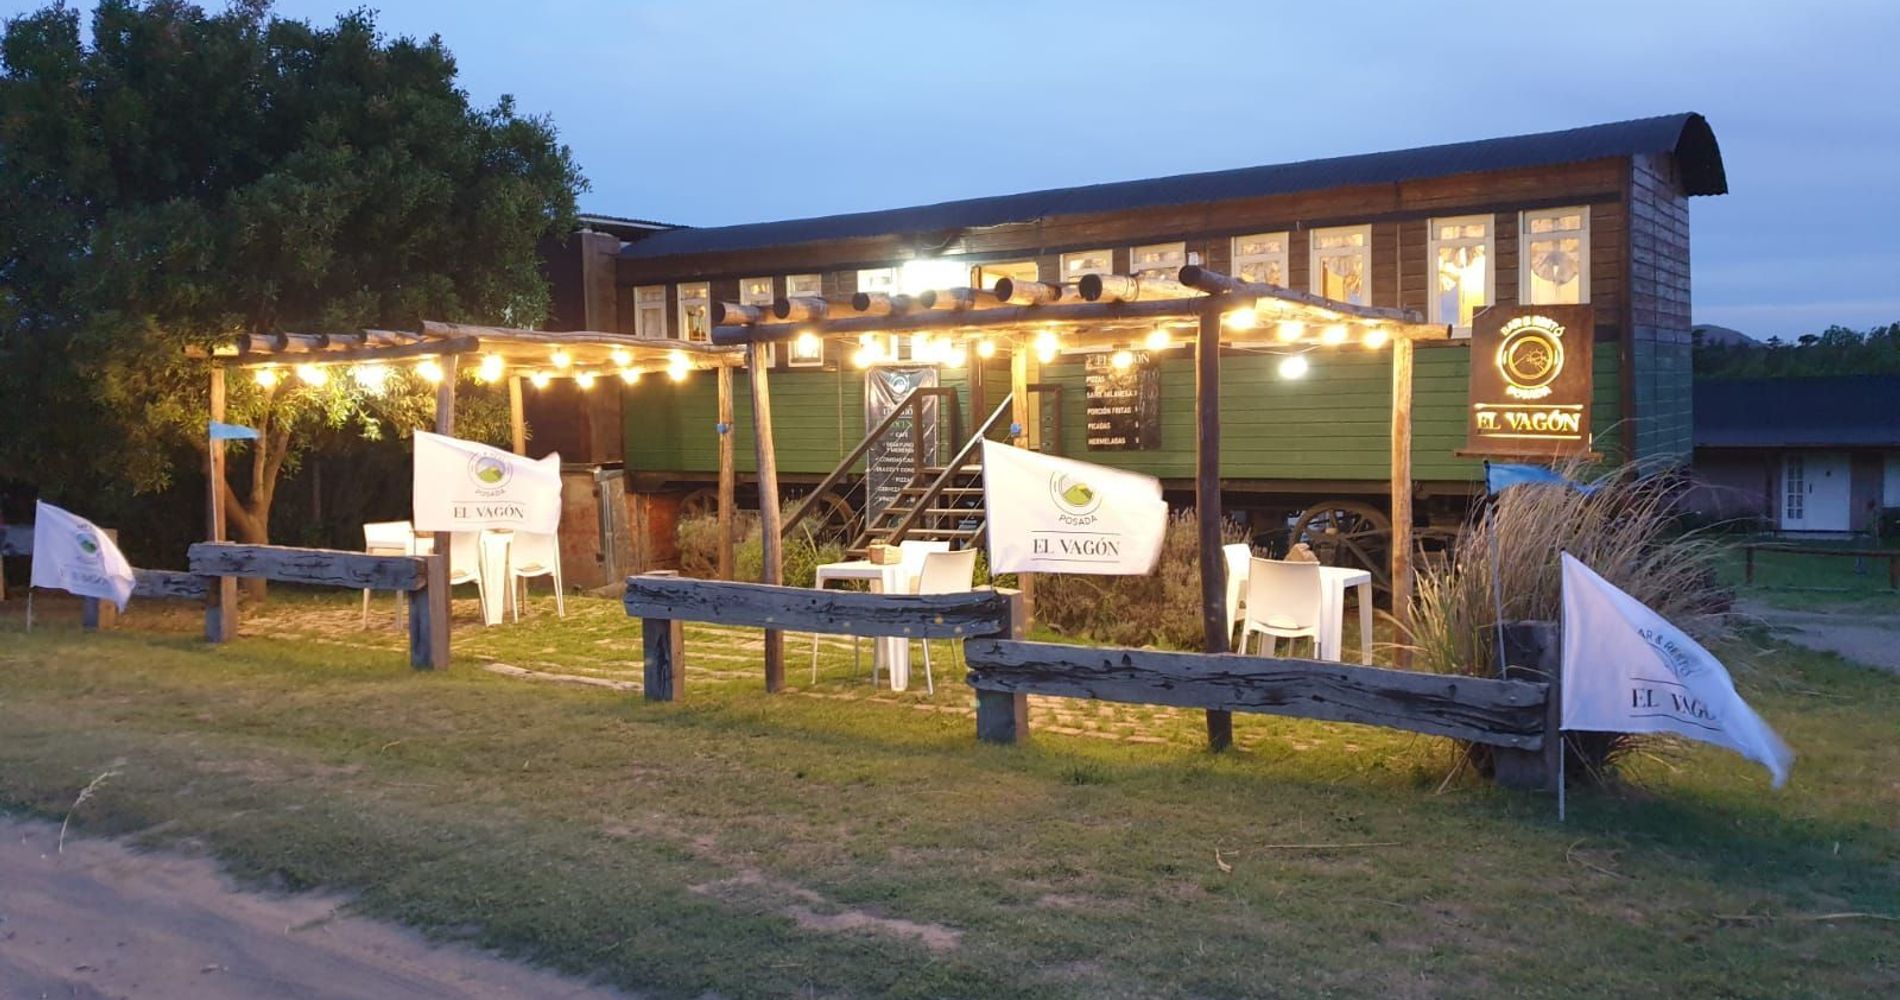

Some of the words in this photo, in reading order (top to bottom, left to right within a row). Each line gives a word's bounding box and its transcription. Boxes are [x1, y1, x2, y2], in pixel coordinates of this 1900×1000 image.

[1087, 406, 1111, 415] PORCIÓN
[1112, 406, 1131, 414] FRITAS
[1476, 411, 1501, 431] EL
[1504, 409, 1581, 432] VAGÓN
[453, 506, 470, 518] EL
[476, 503, 524, 519] VAGÓN
[1058, 513, 1098, 526] POSADA
[1032, 538, 1054, 554] EL
[1060, 536, 1120, 556] VAGÓN
[1637, 628, 1653, 640] AR
[1632, 688, 1659, 708] EL
